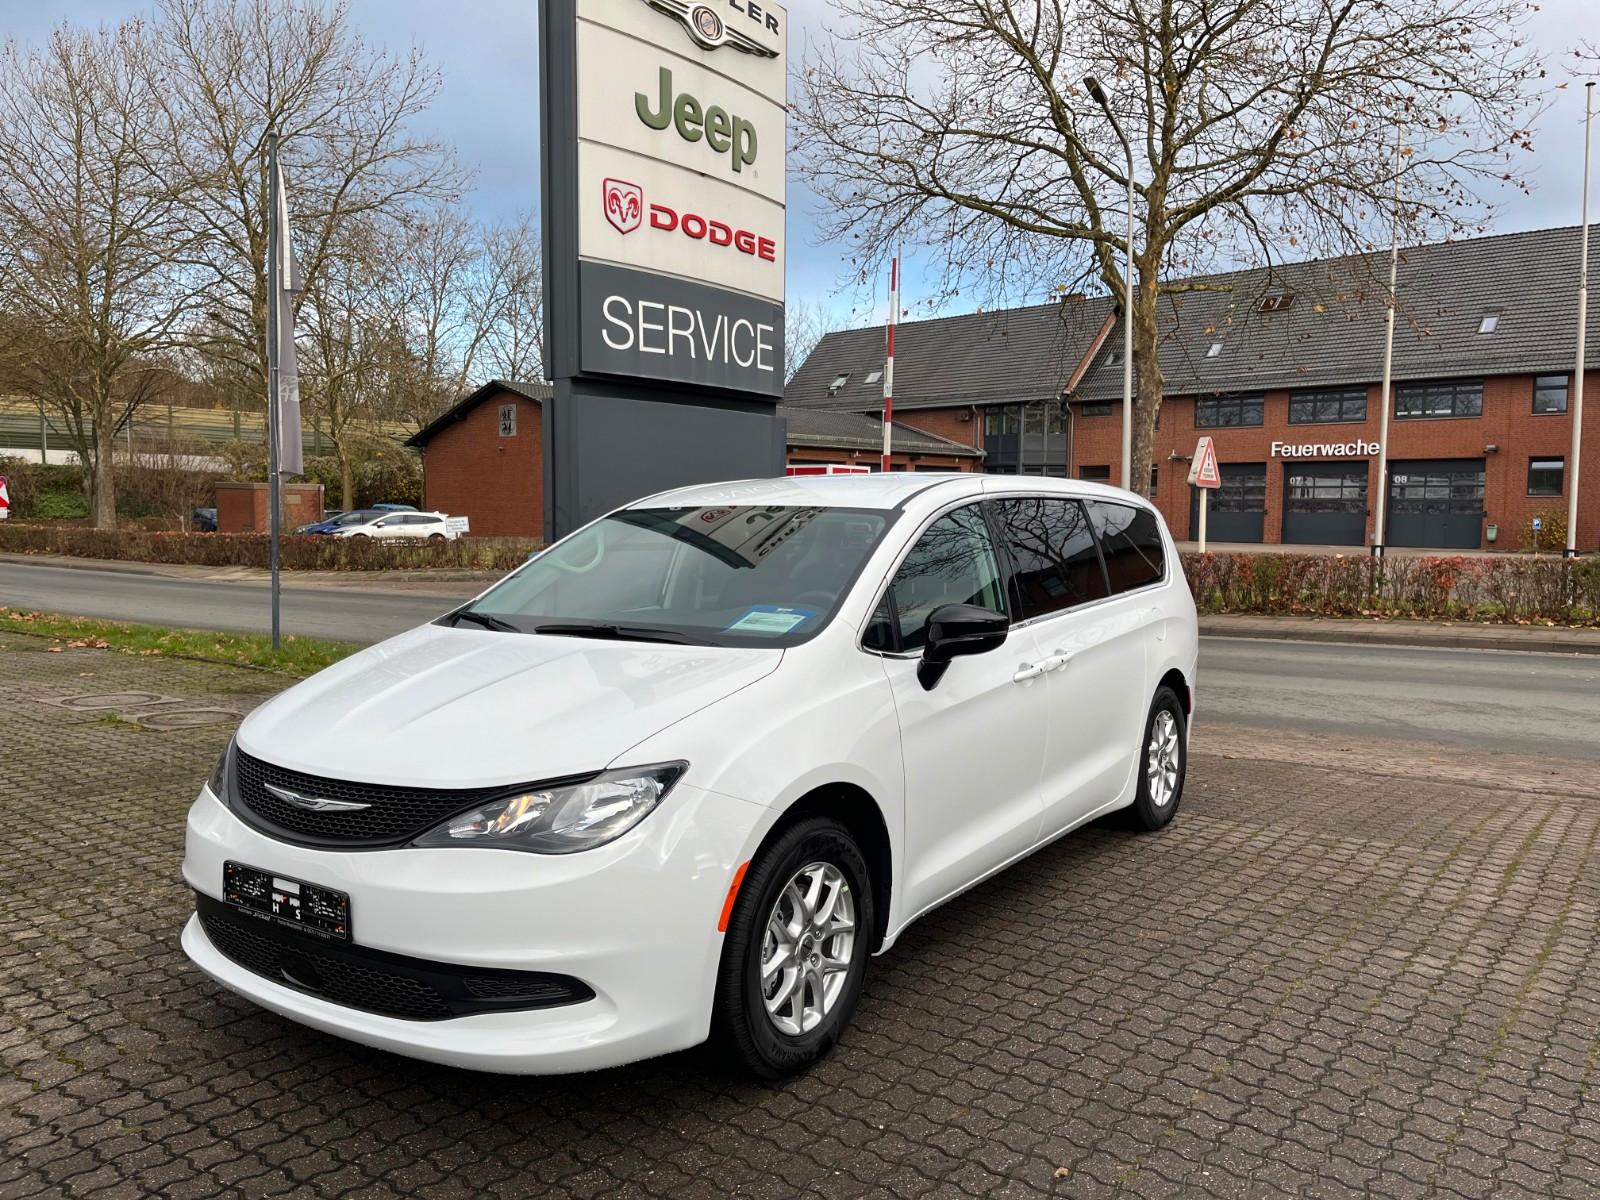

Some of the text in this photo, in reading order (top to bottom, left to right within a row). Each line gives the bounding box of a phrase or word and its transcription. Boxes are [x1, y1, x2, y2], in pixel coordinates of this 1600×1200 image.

[634, 66, 758, 173] Jeep
[650, 203, 776, 263] DODGE
[601, 295, 774, 372] SERVICE
[1270, 439, 1380, 457] Feuerwache
[1289, 476, 1300, 485] 07
[1394, 475, 1408, 484] 08
